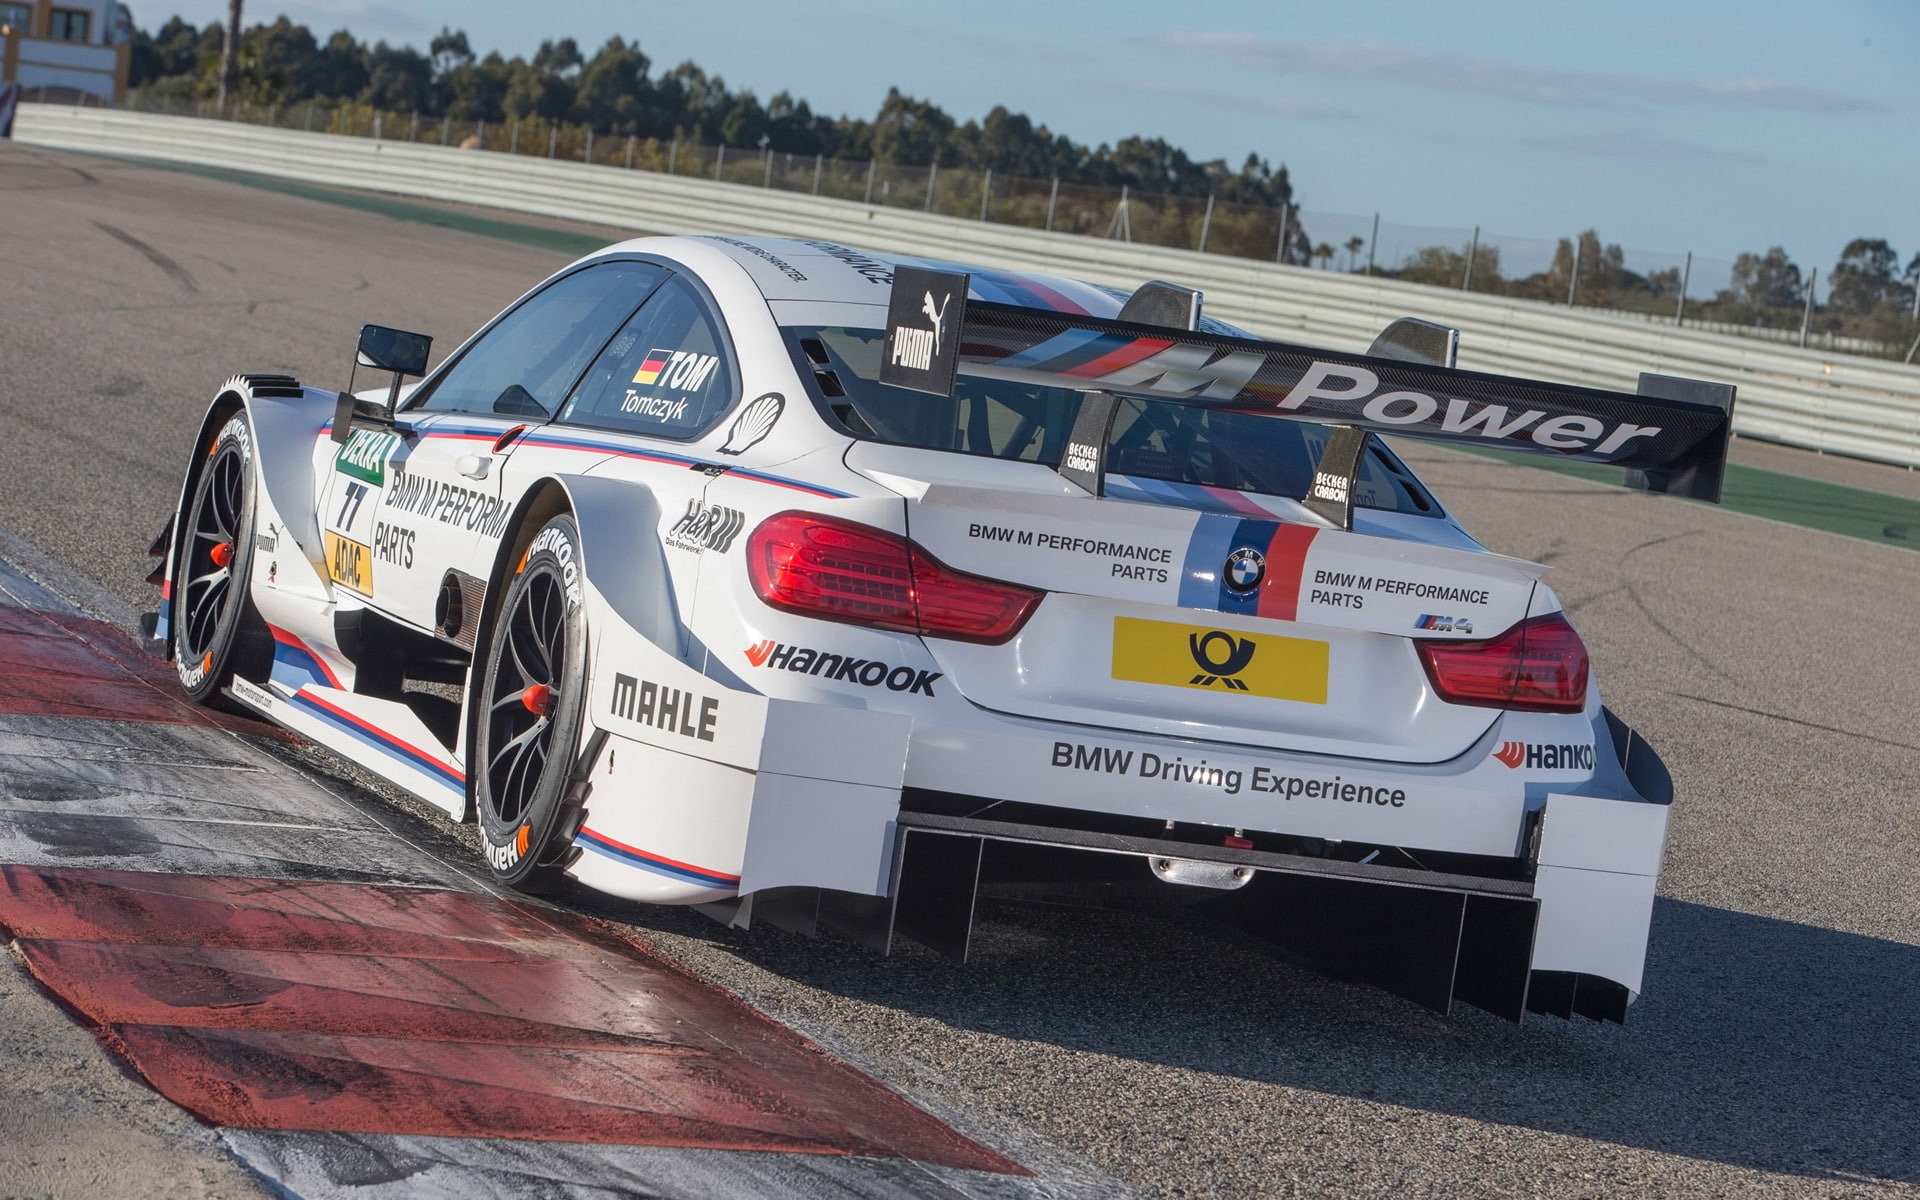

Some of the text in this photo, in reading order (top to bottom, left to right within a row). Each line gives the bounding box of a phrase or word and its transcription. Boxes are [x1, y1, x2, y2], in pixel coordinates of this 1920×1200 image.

[891, 326, 934, 371] PUMA
[658, 351, 719, 392] TOM
[620, 389, 688, 424] Tomczyk
[1276, 360, 1662, 455] Power
[340, 429, 394, 473] DEKRA
[1067, 455, 1097, 473] CARBON
[1068, 442, 1098, 460] BECKER
[1314, 485, 1347, 503] CARBON
[1316, 472, 1348, 490] BECKER
[385, 469, 512, 540] BMW M PERFORM
[334, 537, 361, 588] ADAC
[373, 521, 415, 569] PARTS
[968, 523, 1173, 564] BMW M PERFORMANCE
[1111, 564, 1168, 583] PARTS
[1314, 570, 1490, 605] BMW M PERFORMANCE
[1310, 589, 1364, 609] PARTS
[1426, 614, 1473, 635] M4
[766, 643, 945, 698] Hankook
[611, 672, 719, 742] MAHLE
[1051, 741, 1406, 808] BMW Driving Experience
